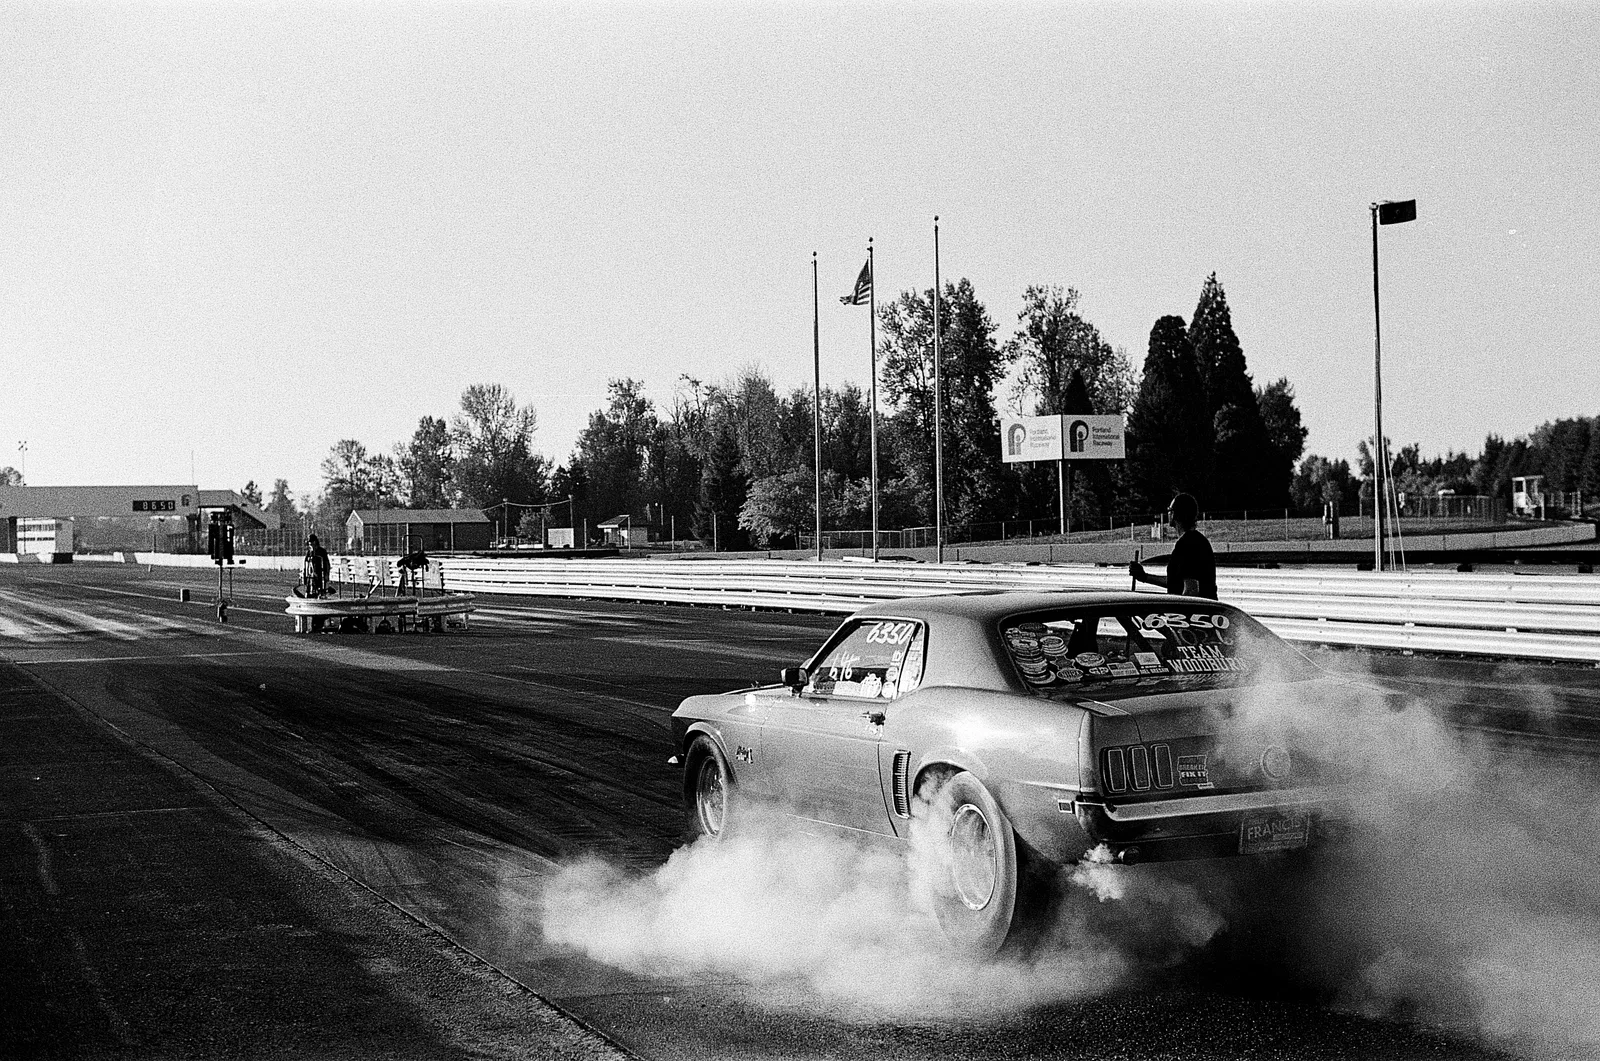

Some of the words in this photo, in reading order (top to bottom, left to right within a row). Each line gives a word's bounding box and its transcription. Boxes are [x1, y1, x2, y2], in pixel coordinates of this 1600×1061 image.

[1092, 440, 1113, 448] Raceway
[1144, 613, 1230, 629] 6350
[866, 622, 914, 644] 6350
[1177, 645, 1225, 659] TEAM
[1167, 657, 1249, 672] WOODBURN
